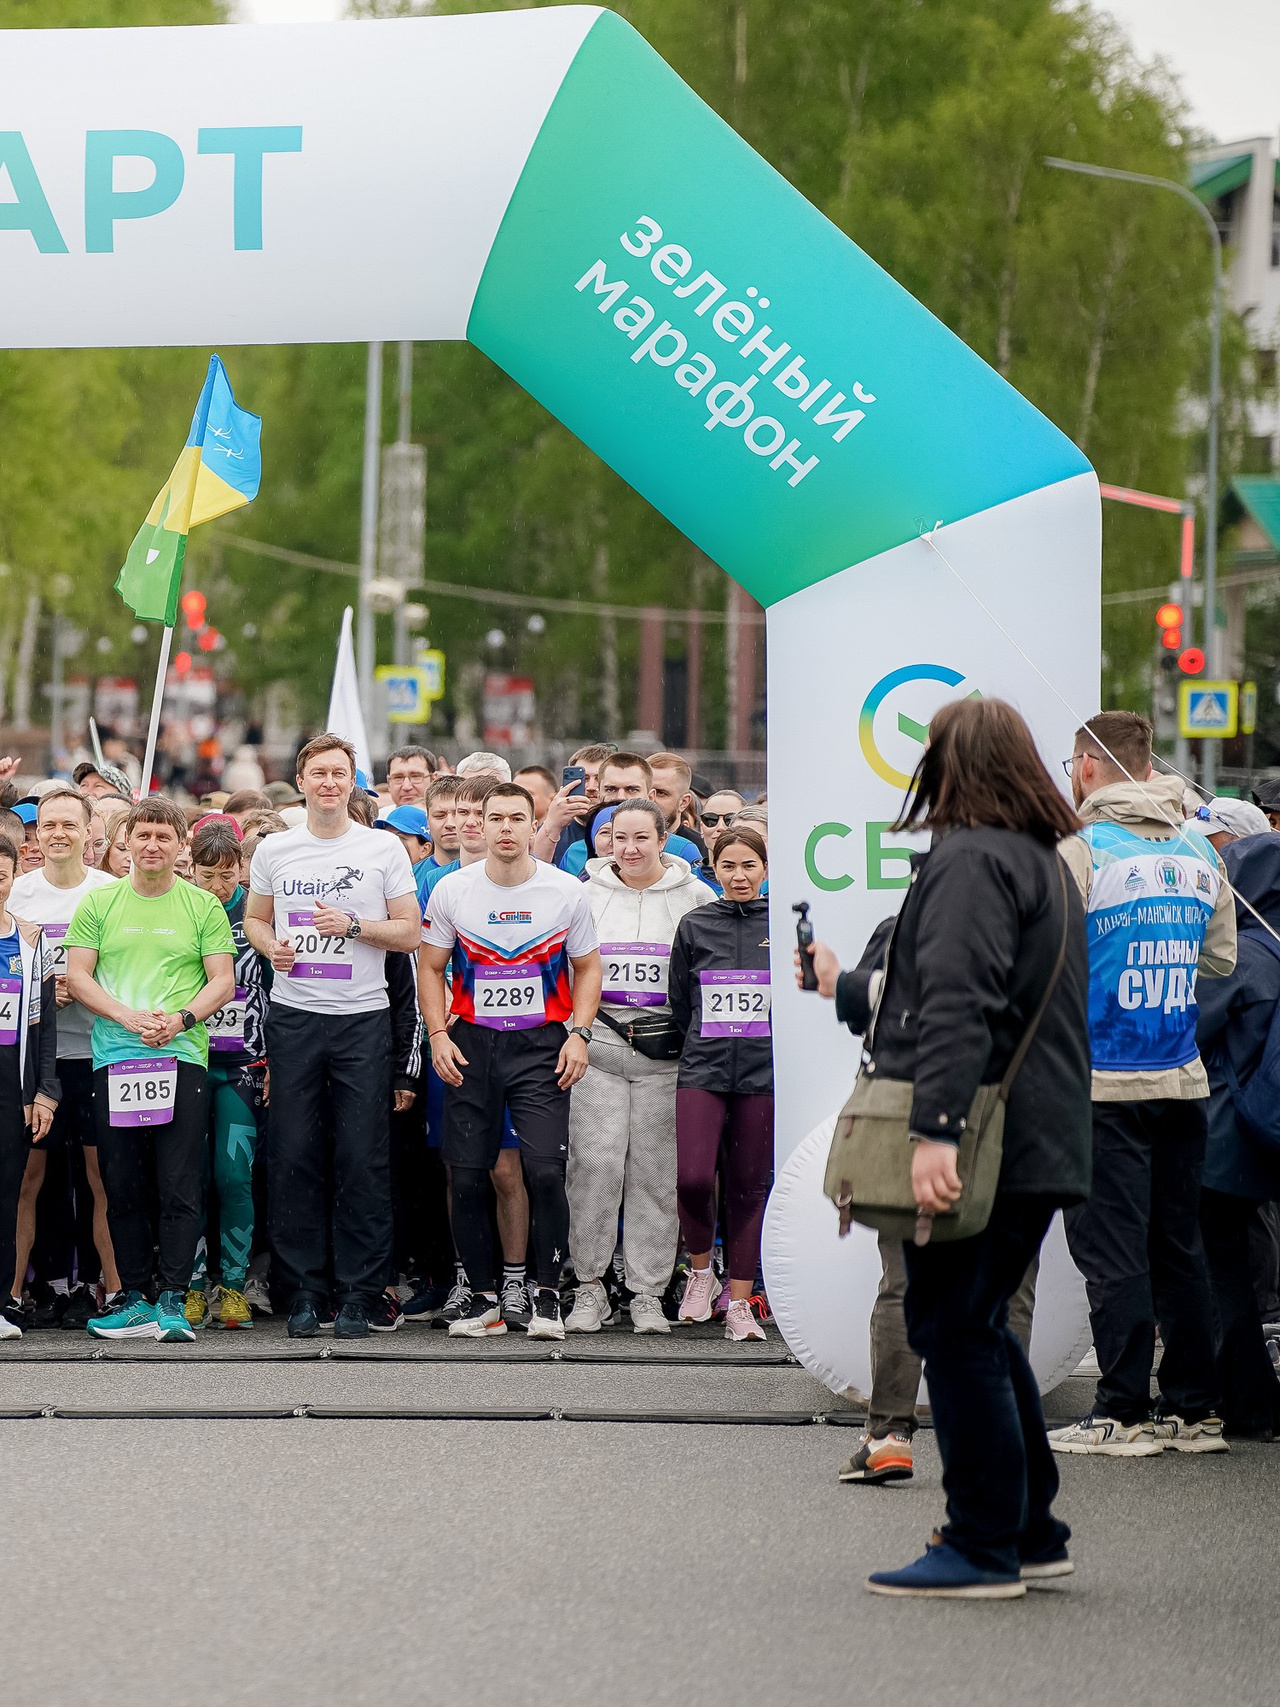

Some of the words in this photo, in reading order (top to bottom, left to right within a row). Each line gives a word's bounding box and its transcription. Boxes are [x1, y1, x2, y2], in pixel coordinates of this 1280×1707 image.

[619, 214, 877, 444] зелёный
[573, 258, 820, 488] марафон
[283, 878, 329, 896] Utair
[295, 934, 346, 955] 2072
[608, 963, 661, 983] 2153
[483, 986, 535, 1007] 2289
[711, 993, 764, 1012] 2152
[205, 1009, 237, 1028] 93
[120, 1080, 171, 1102] 2185
